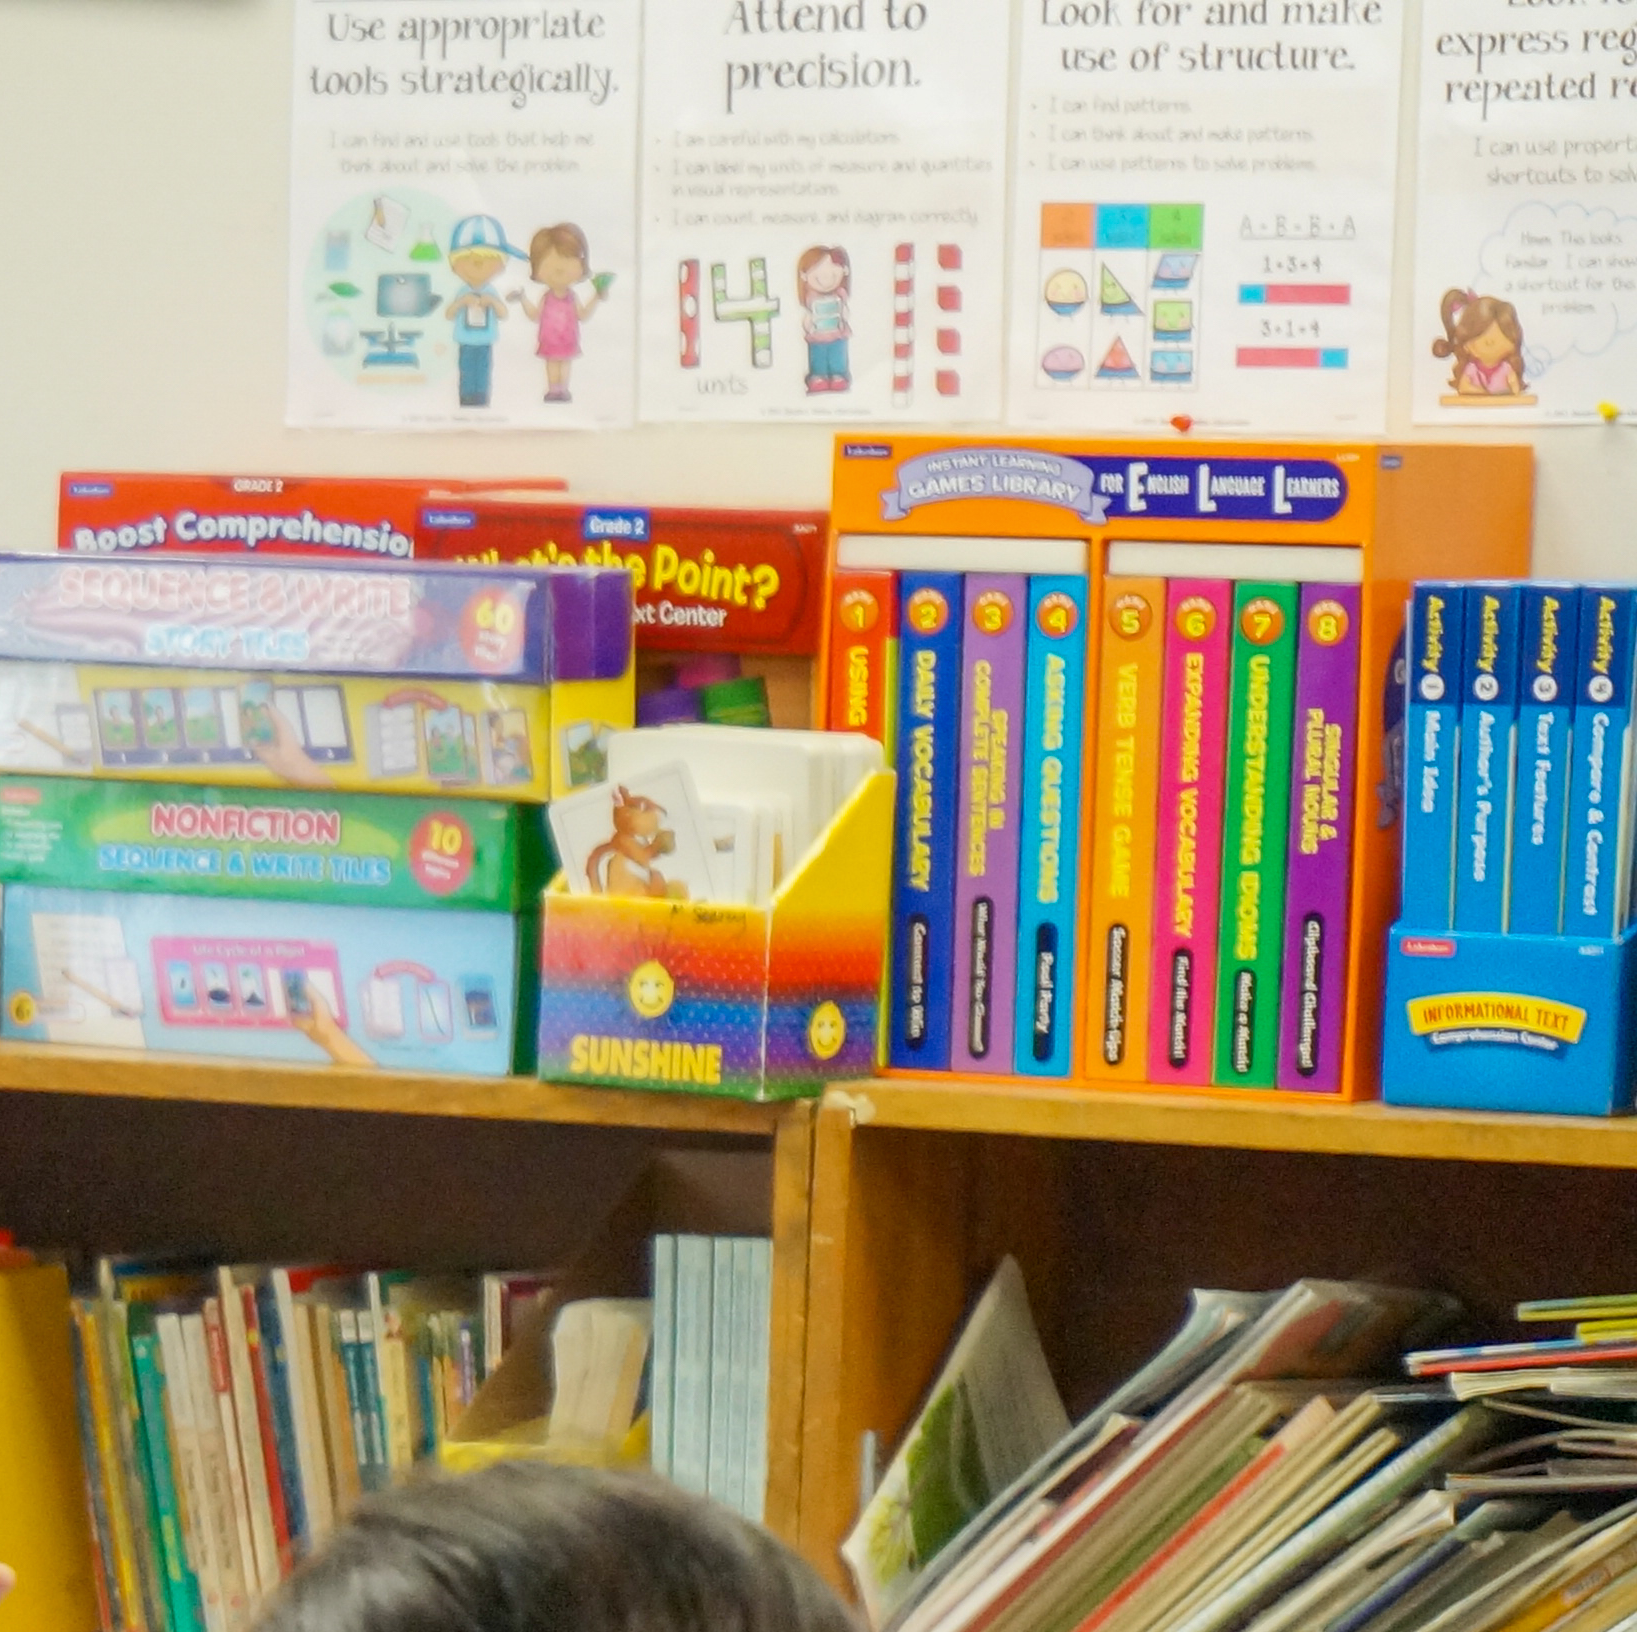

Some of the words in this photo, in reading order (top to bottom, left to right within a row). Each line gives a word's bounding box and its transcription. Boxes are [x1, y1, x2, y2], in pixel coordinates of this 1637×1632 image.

[327, 11, 387, 42] Use
[397, 8, 606, 60] appropriate
[724, 0, 866, 34] Attend
[885, 0, 928, 31] to
[1039, 0, 1122, 26] Look
[1135, 0, 1192, 26] for
[1204, 0, 1267, 26] and
[1282, 0, 1382, 26] make
[1060, 46, 1117, 72] use
[1128, 42, 1170, 72] of
[1178, 41, 1357, 73] structure.
[1436, 30, 1569, 74] express
[310, 63, 390, 95] tools
[400, 62, 620, 110] strategically.
[724, 51, 923, 115] precision.
[1445, 71, 1597, 121] repeated
[696, 376, 749, 397] units
[908, 474, 985, 499] GAMES
[992, 474, 1082, 502] LIBRARY
[927, 454, 987, 473] INSTANT
[991, 454, 1063, 476] LEARNING
[74, 514, 167, 553] Boost
[59, 567, 251, 612] SEQUENCE
[258, 573, 286, 614] &
[295, 574, 411, 620] WRITE
[653, 543, 780, 611] Point?
[474, 598, 515, 635] 60
[659, 601, 728, 629] Center
[854, 605, 865, 628] 1
[920, 607, 937, 629] 2
[983, 606, 1003, 630] 3
[1048, 609, 1068, 633] 4
[1120, 609, 1141, 634] 5
[1185, 613, 1206, 637] 6
[1253, 613, 1272, 638] 7
[1318, 615, 1338, 641] 8
[1421, 594, 1446, 673] Activity
[1476, 594, 1501, 673] Activity
[1535, 594, 1561, 674] Activity
[1591, 594, 1617, 675] Activity
[848, 645, 869, 726] USING
[914, 649, 937, 719] DAILY
[1043, 652, 1066, 750] ASKING
[1117, 662, 1138, 728] VERB
[1181, 652, 1205, 784] EXPANDING
[1112, 735, 1135, 817] TENSE
[1240, 653, 1271, 866] UNDERSTANDING
[1586, 711, 1610, 805] Compare
[151, 802, 341, 845] NONFICTION
[910, 724, 935, 892] VOCABULARY
[1038, 755, 1063, 903] QUESTIONS
[430, 820, 463, 855] 10
[1110, 824, 1133, 898] GAME
[99, 844, 221, 876] SEQUENCE
[251, 851, 325, 882] WRITE
[329, 855, 392, 885] TILES
[1174, 786, 1199, 939] VOCABULARY
[1235, 871, 1260, 961] IDIOMS
[1422, 1001, 1530, 1025] INFORMATIONAL
[1535, 1007, 1570, 1032] TEXT
[570, 1033, 723, 1086] SUNSHINE
